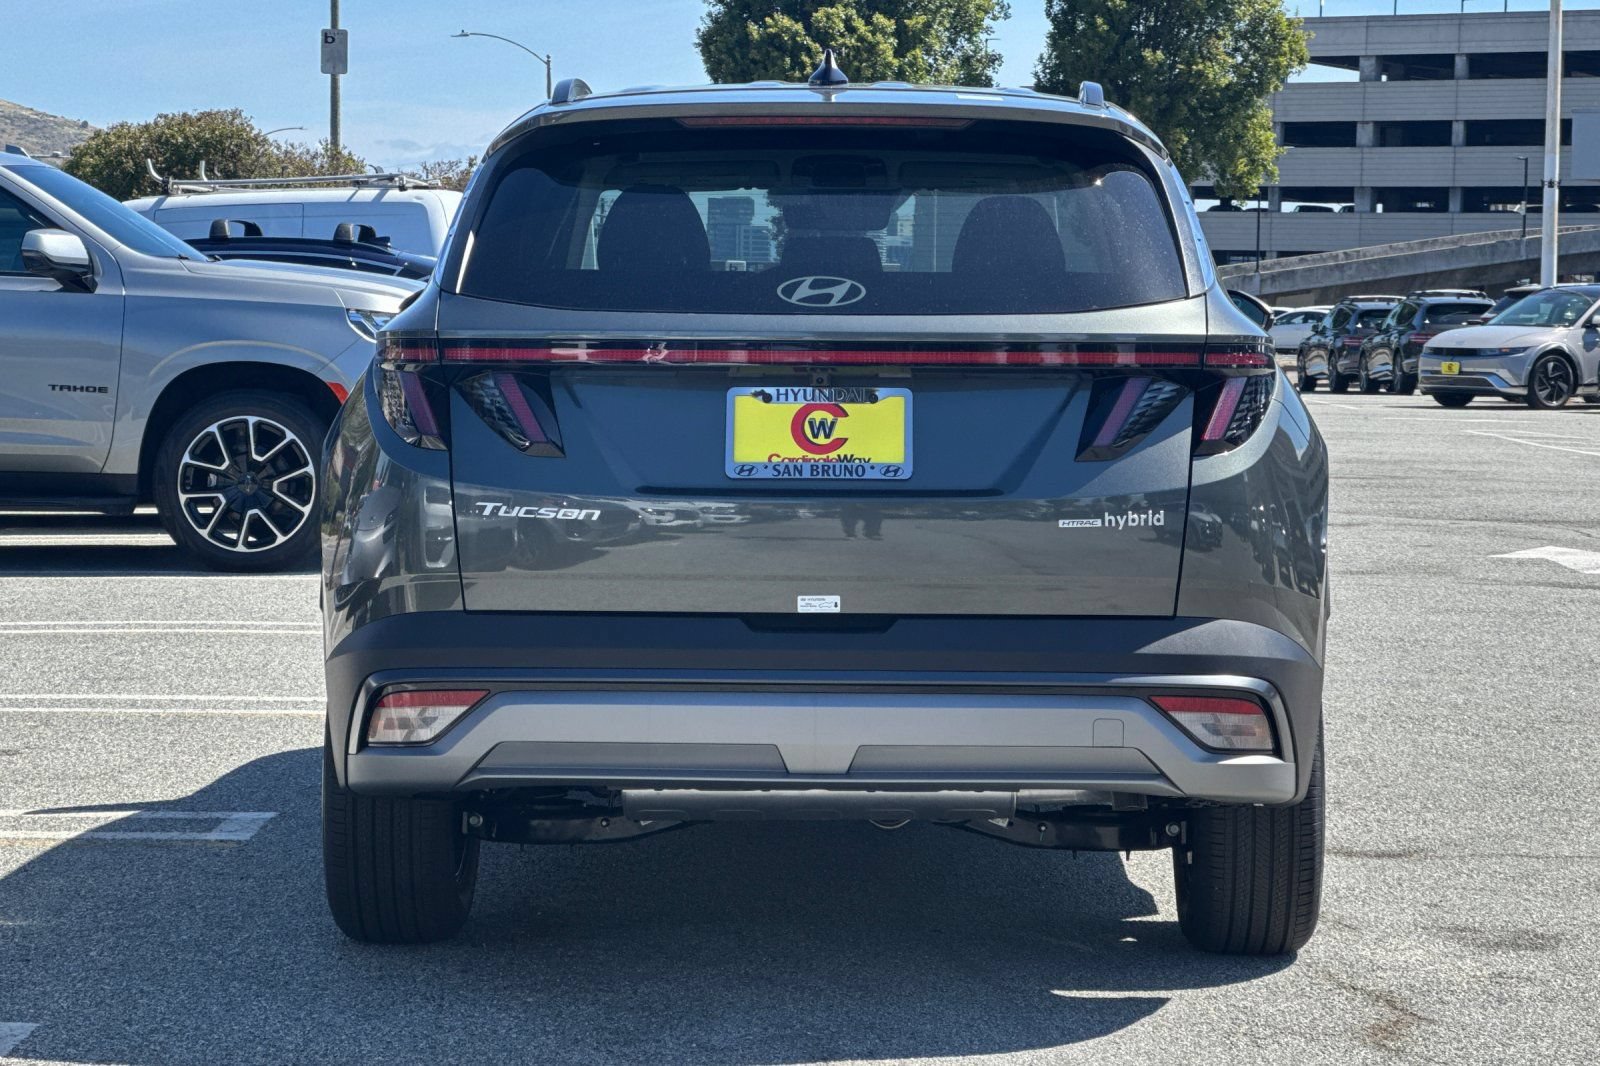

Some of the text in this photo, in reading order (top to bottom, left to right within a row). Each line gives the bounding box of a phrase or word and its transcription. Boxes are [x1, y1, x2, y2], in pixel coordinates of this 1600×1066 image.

[47, 384, 109, 394] TAHOE
[775, 388, 866, 402] HYUNDAI
[771, 464, 866, 478] SAN BRUNO
[1061, 510, 1165, 530] HTRAC hybrid
